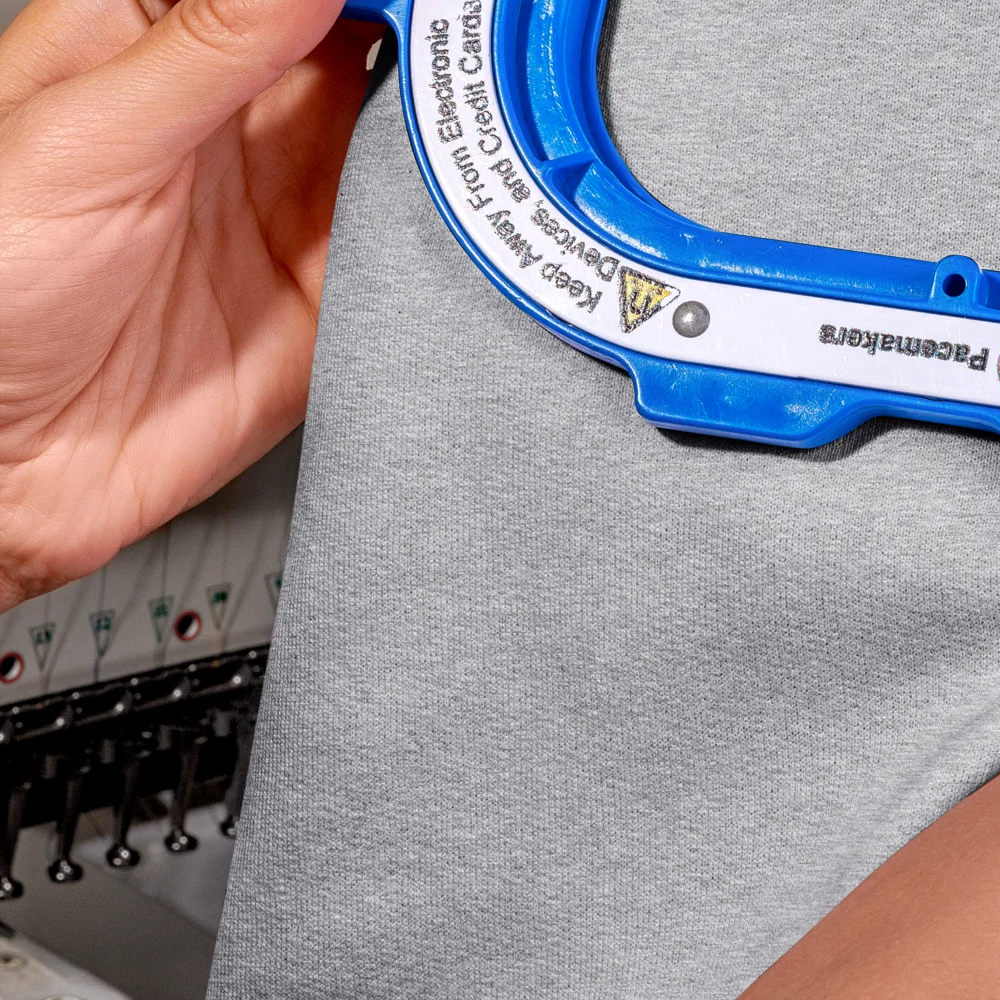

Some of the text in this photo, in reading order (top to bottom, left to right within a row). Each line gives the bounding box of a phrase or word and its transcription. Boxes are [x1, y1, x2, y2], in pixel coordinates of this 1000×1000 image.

[428, 18, 603, 313] Keep Away From Electronic
[457, 0, 621, 283] Devices, and Credit Cards
[818, 323, 990, 372] Pacemakers
